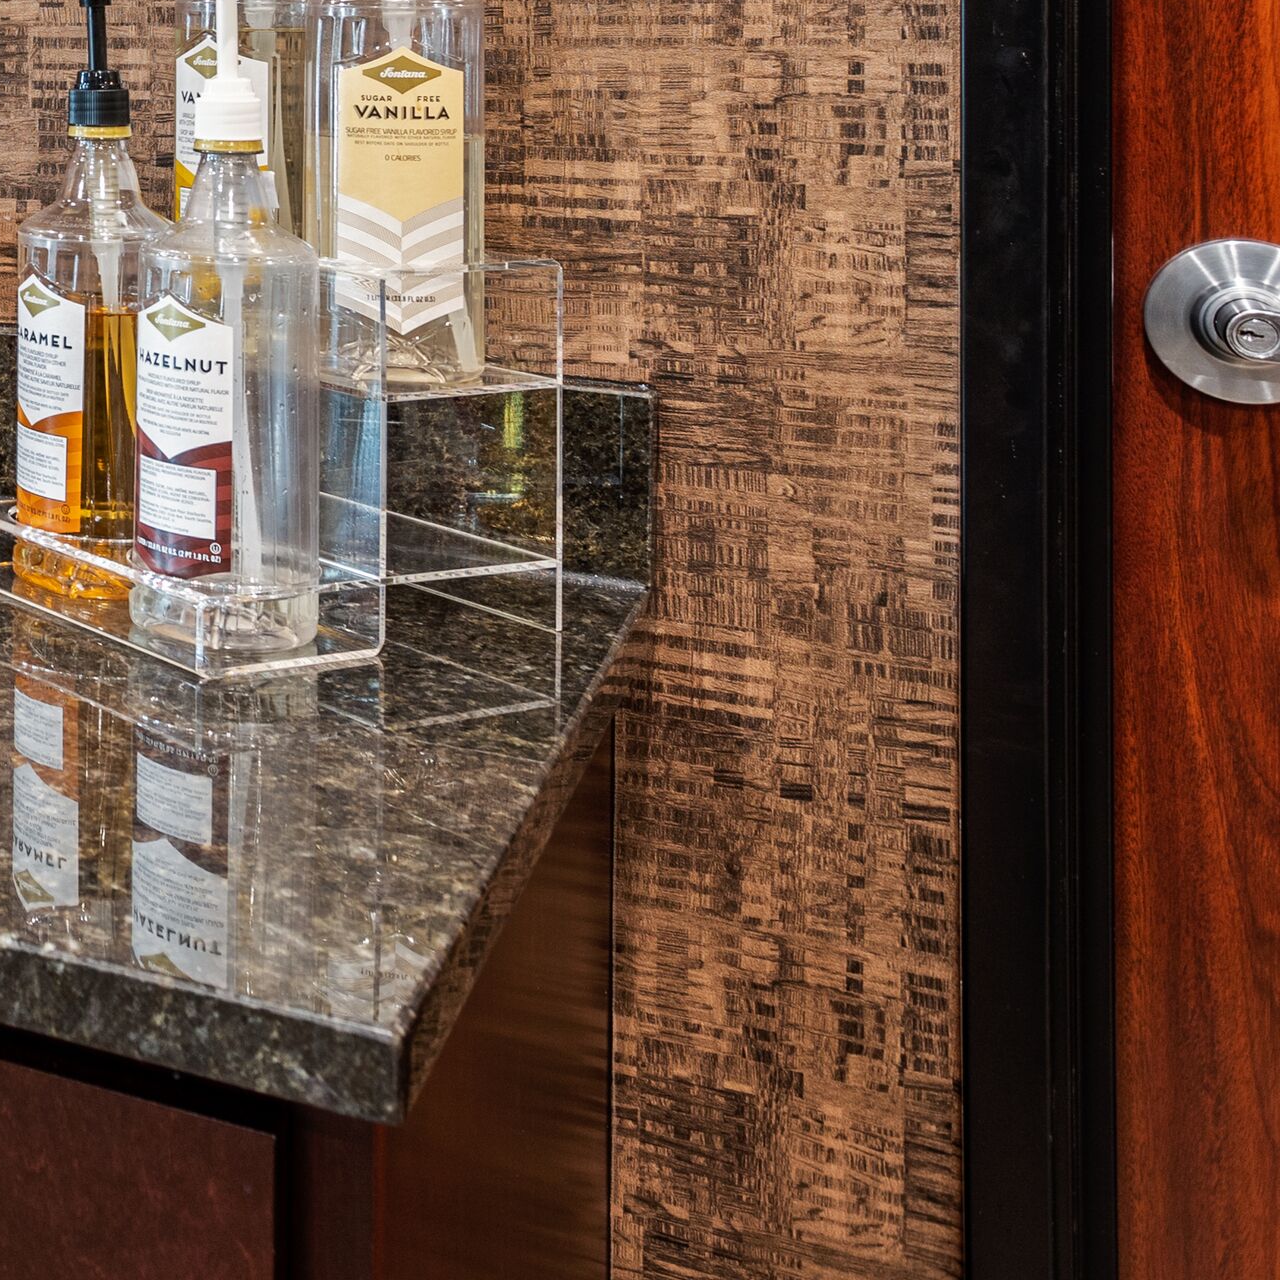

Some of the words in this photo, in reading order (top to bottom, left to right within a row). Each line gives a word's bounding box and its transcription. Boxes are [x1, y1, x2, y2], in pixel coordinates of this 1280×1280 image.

[380, 66, 426, 79] Fontana
[360, 94, 393, 102] SUGAR
[417, 95, 441, 103] FREE
[354, 105, 450, 120] VANILLA
[139, 347, 228, 375] HAZELNUT
